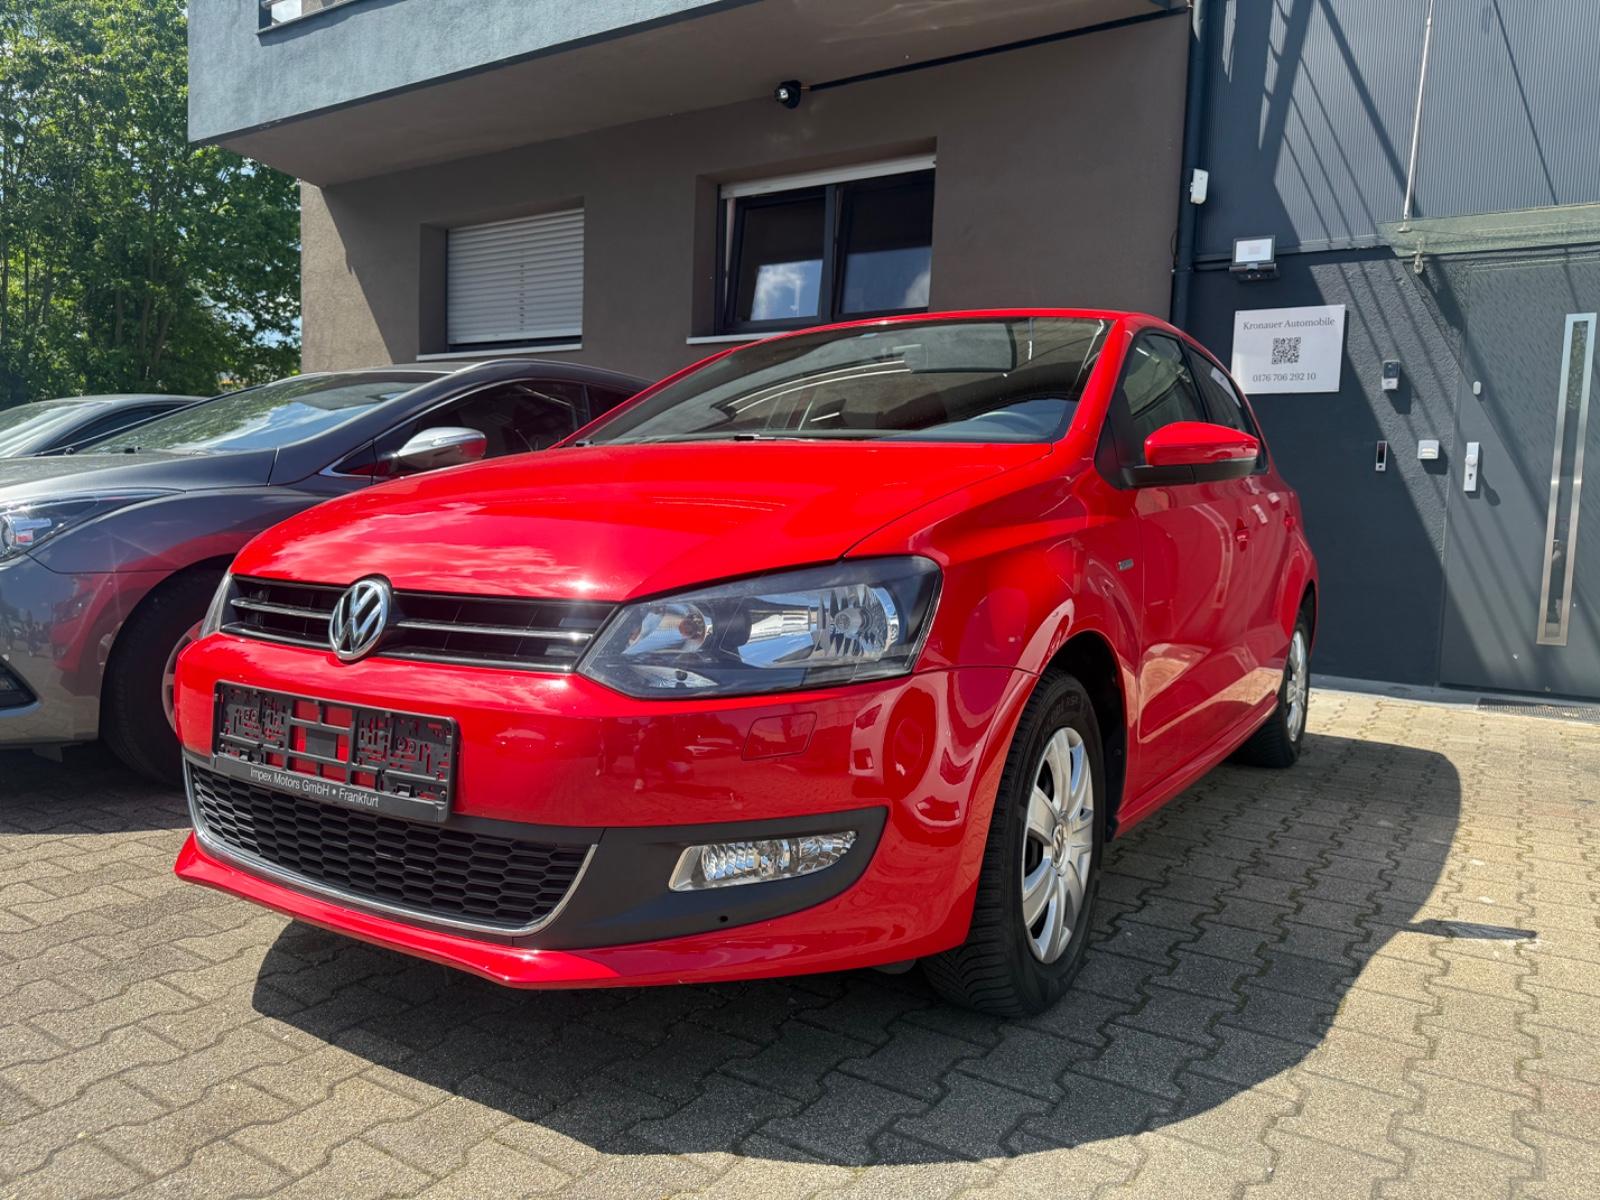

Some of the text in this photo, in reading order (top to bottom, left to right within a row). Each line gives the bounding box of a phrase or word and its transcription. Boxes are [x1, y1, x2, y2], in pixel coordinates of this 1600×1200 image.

[1243, 317, 1335, 331] Kronauer Automobile
[1252, 372, 1317, 383] 0176 706 292 10
[250, 767, 380, 808] Impex Motors GmbH Frankfurt
